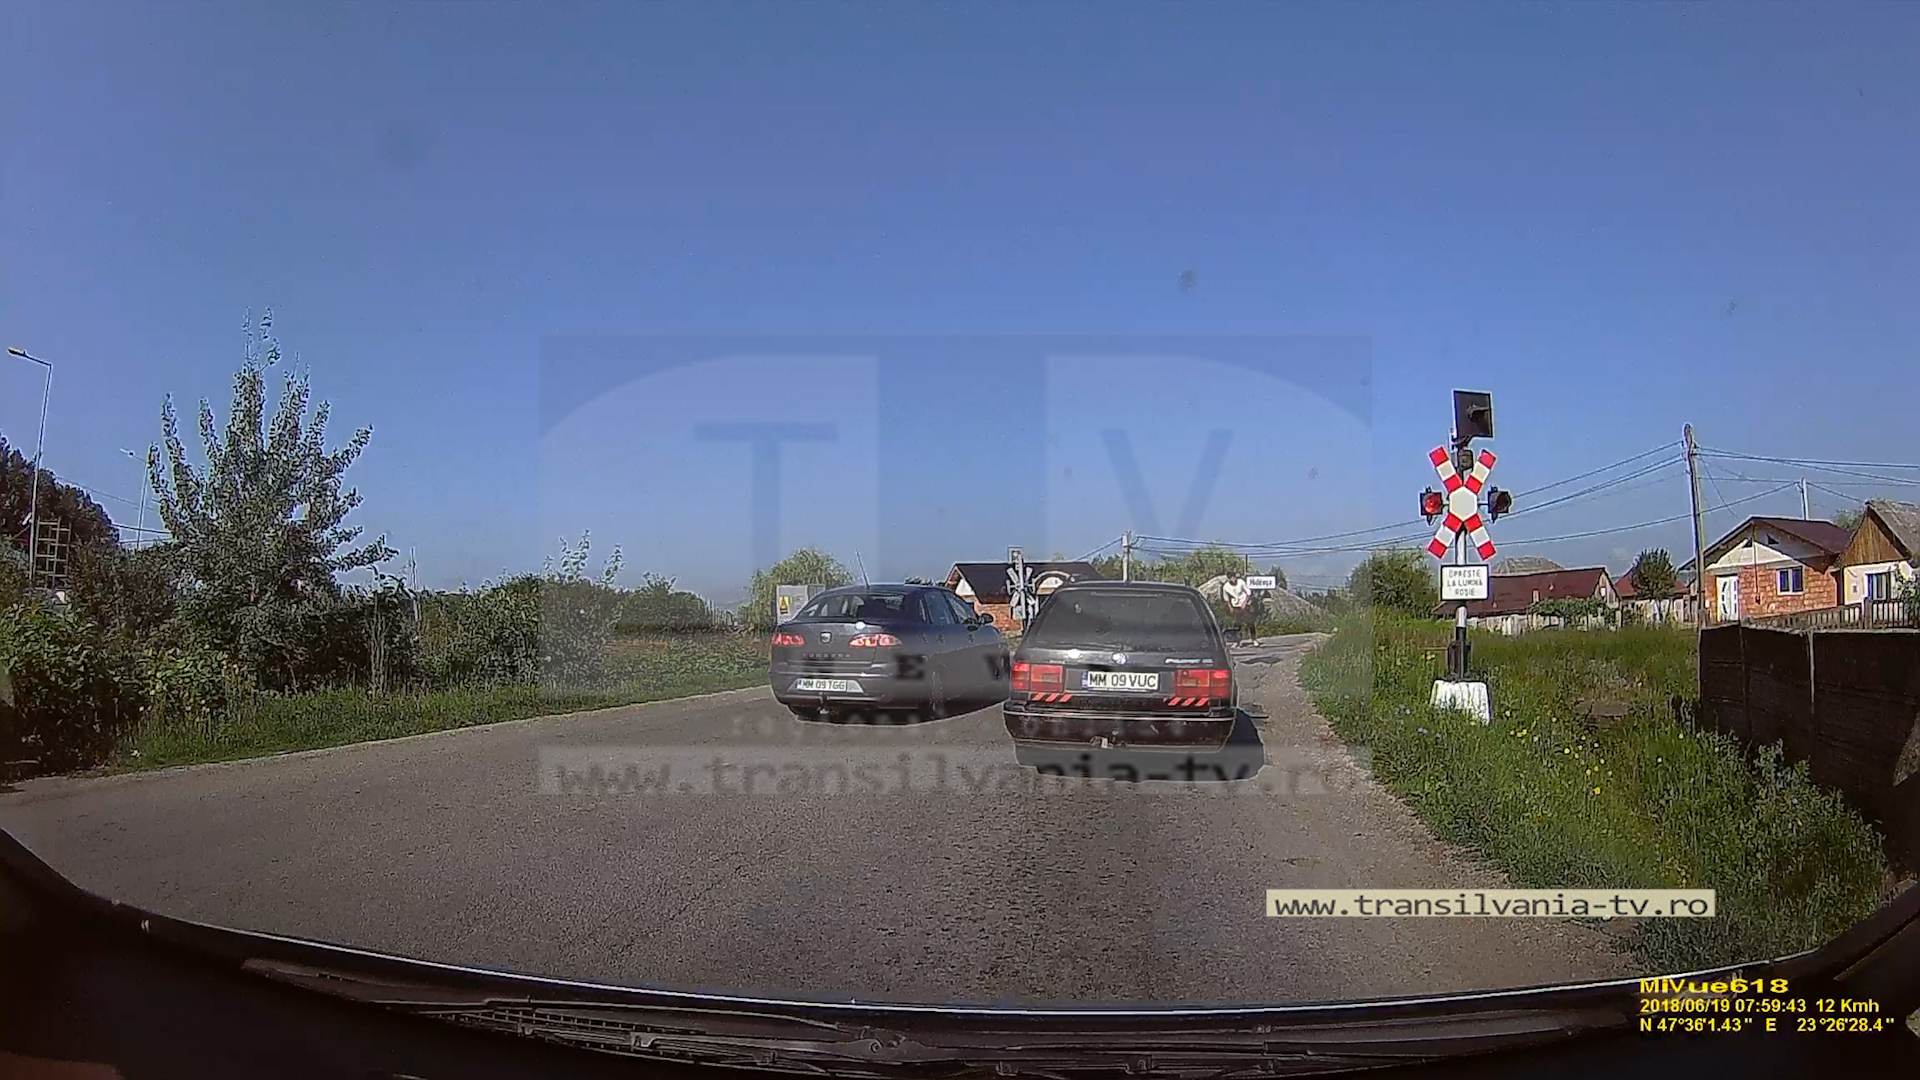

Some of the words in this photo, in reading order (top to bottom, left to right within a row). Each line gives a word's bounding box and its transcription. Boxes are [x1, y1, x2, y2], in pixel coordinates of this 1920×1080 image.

[1089, 673, 1107, 686] MM
[1111, 674, 1127, 687] 09
[1128, 674, 1156, 688] VUC
